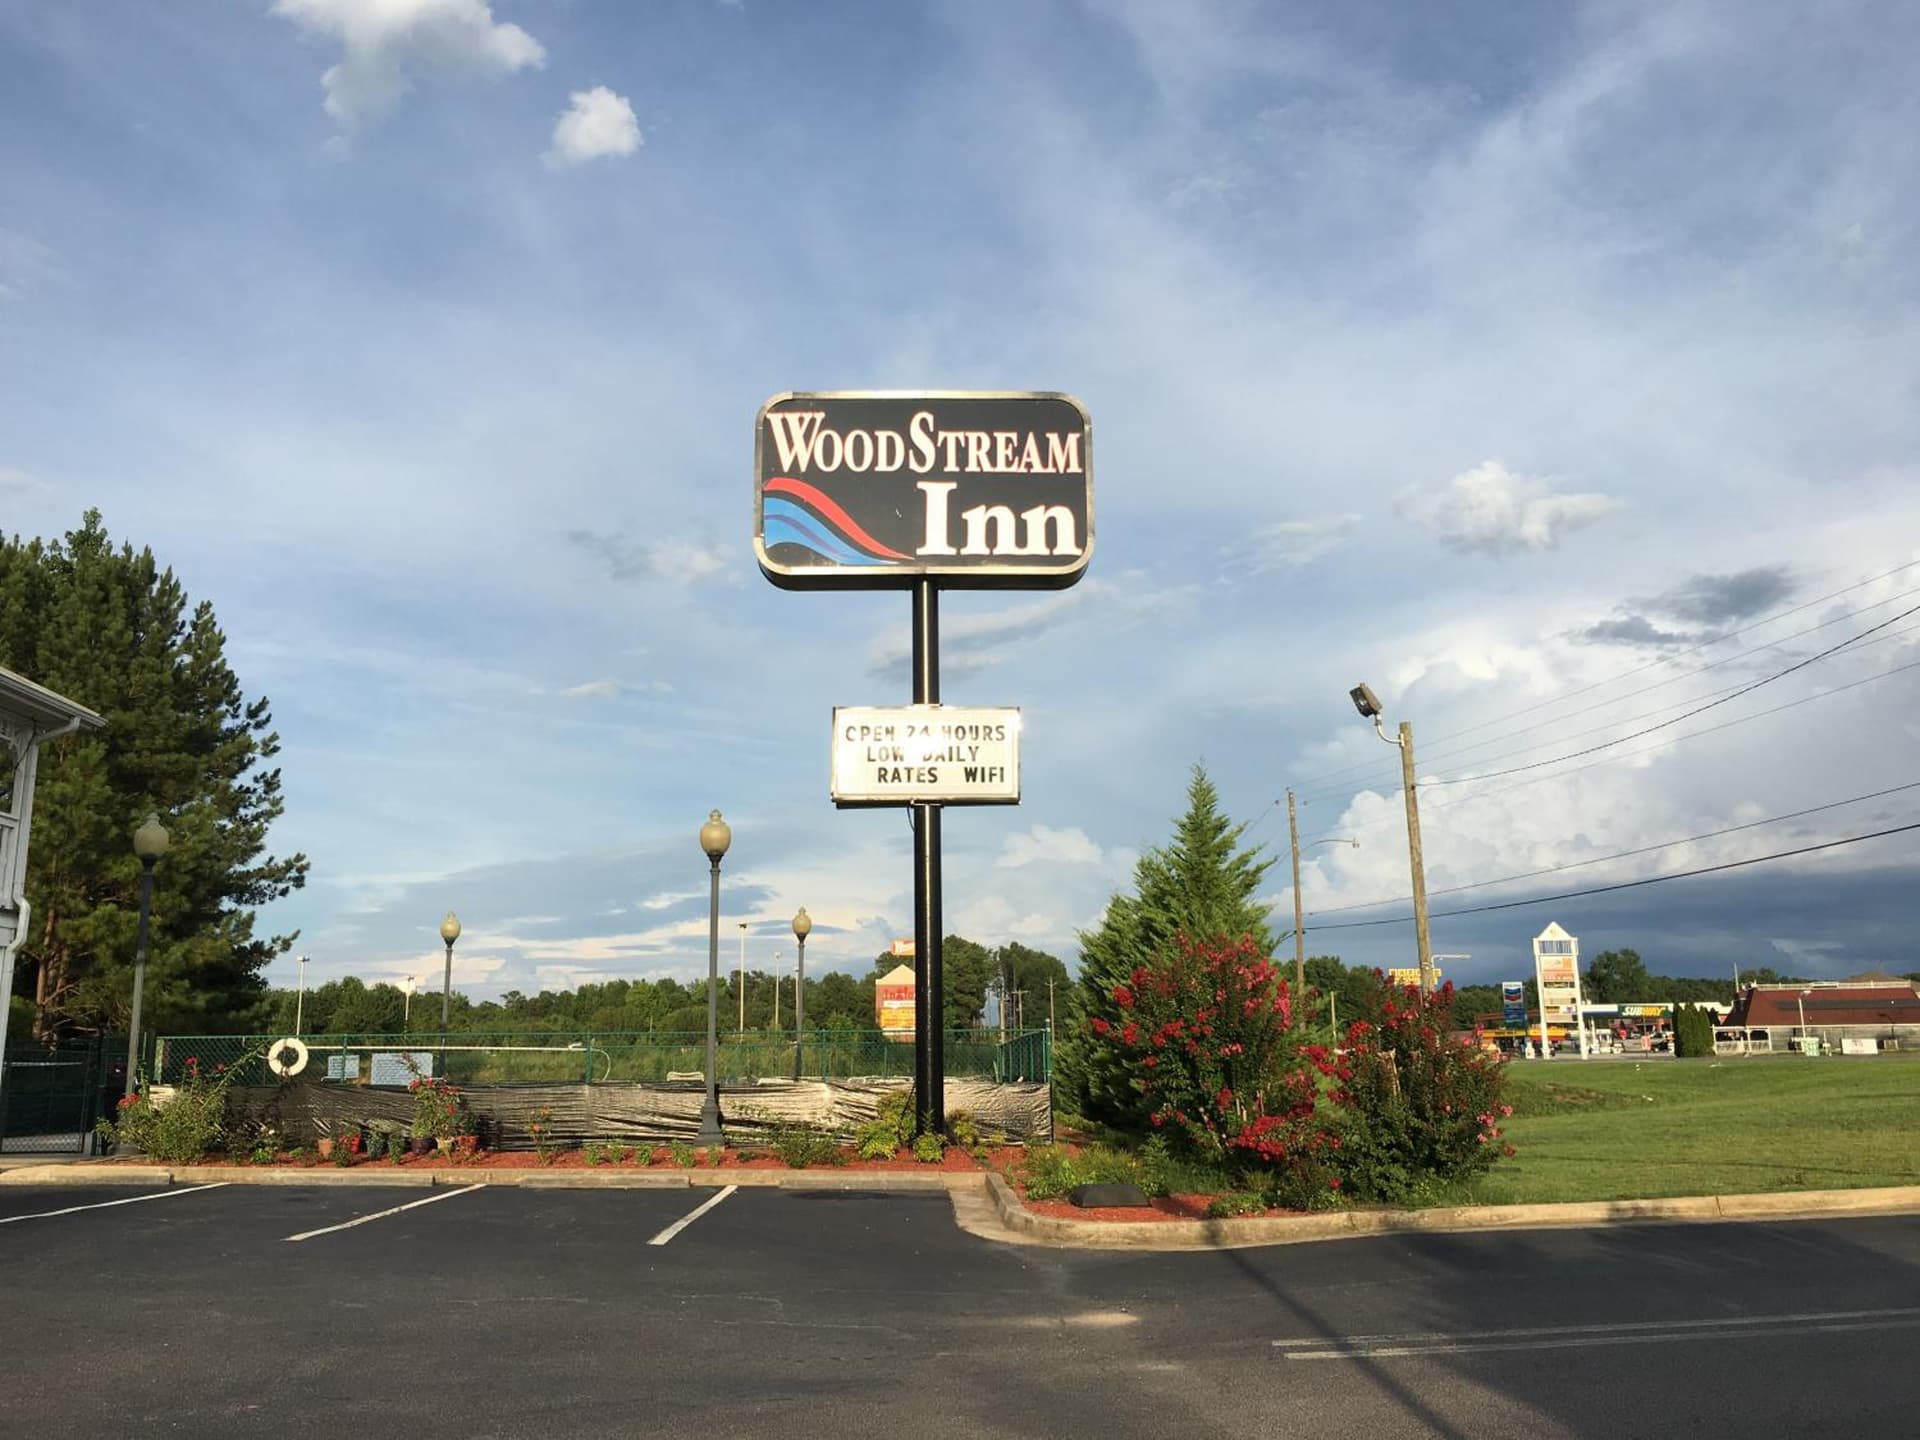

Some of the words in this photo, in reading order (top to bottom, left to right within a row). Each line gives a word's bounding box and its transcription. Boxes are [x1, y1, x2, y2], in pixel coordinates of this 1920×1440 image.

[916, 481, 1083, 556] Inn
[867, 746, 905, 762] LOW
[878, 767, 938, 783] RATES
[964, 767, 1006, 783] WIFI
[1622, 1006, 1666, 1016] SUBWAY
